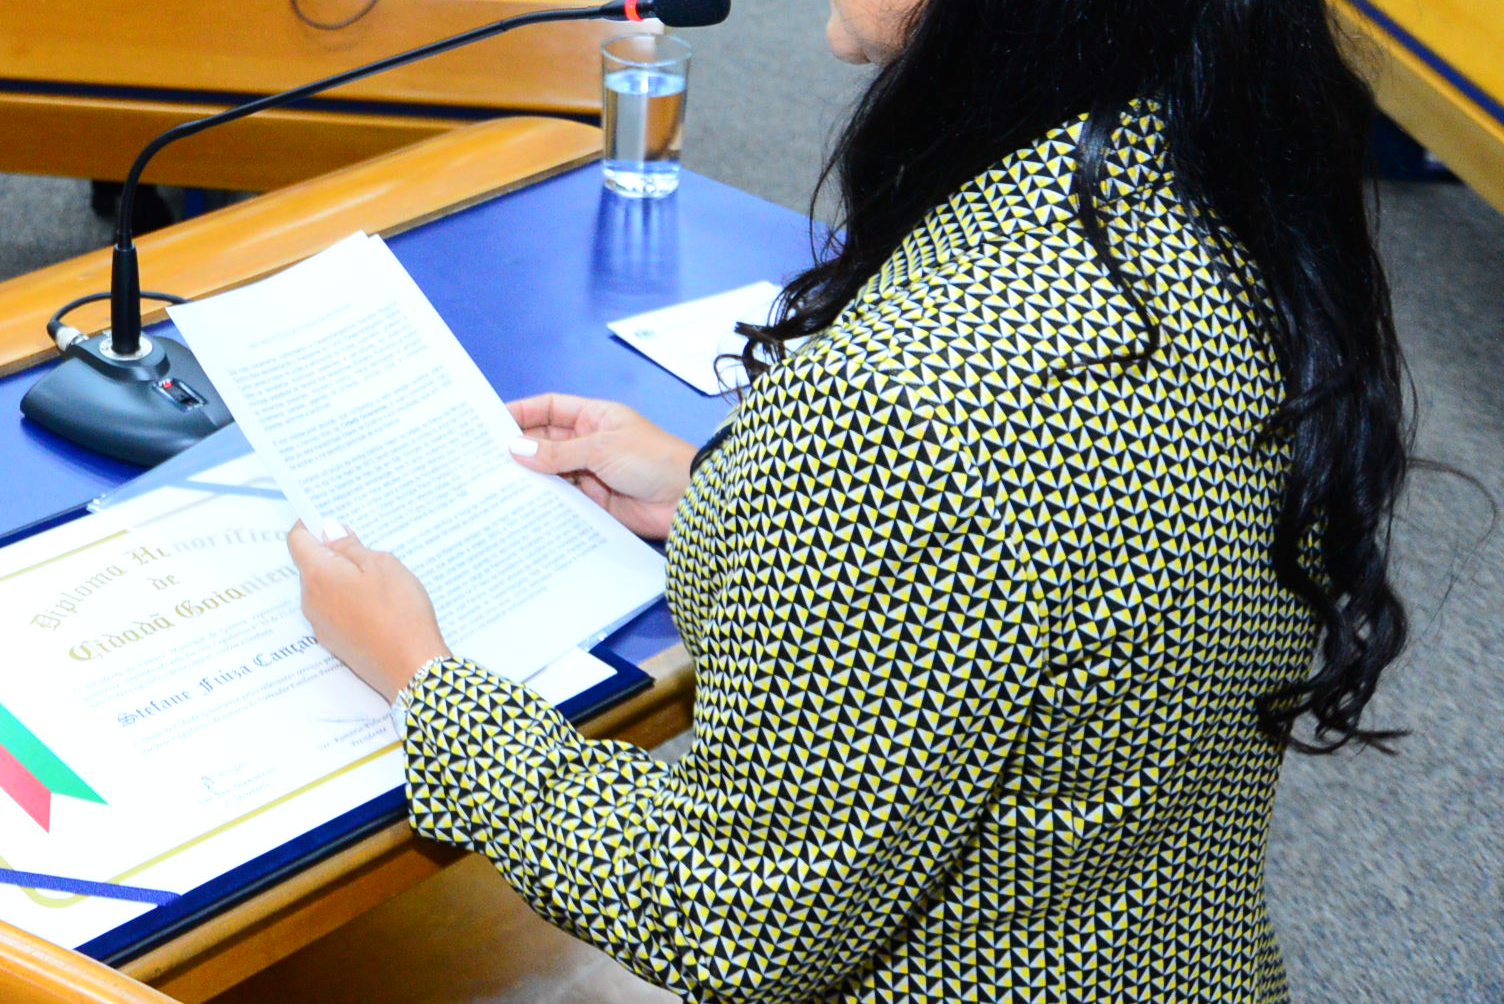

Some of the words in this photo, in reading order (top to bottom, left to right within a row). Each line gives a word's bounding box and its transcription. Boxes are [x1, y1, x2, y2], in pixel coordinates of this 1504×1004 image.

[30, 565, 128, 631] Diploma
[146, 574, 181, 591] de
[68, 612, 176, 662] Cidadã
[117, 688, 194, 727] Stefane
[198, 664, 253, 697] Fiúza
[252, 634, 319, 668] Cançad
